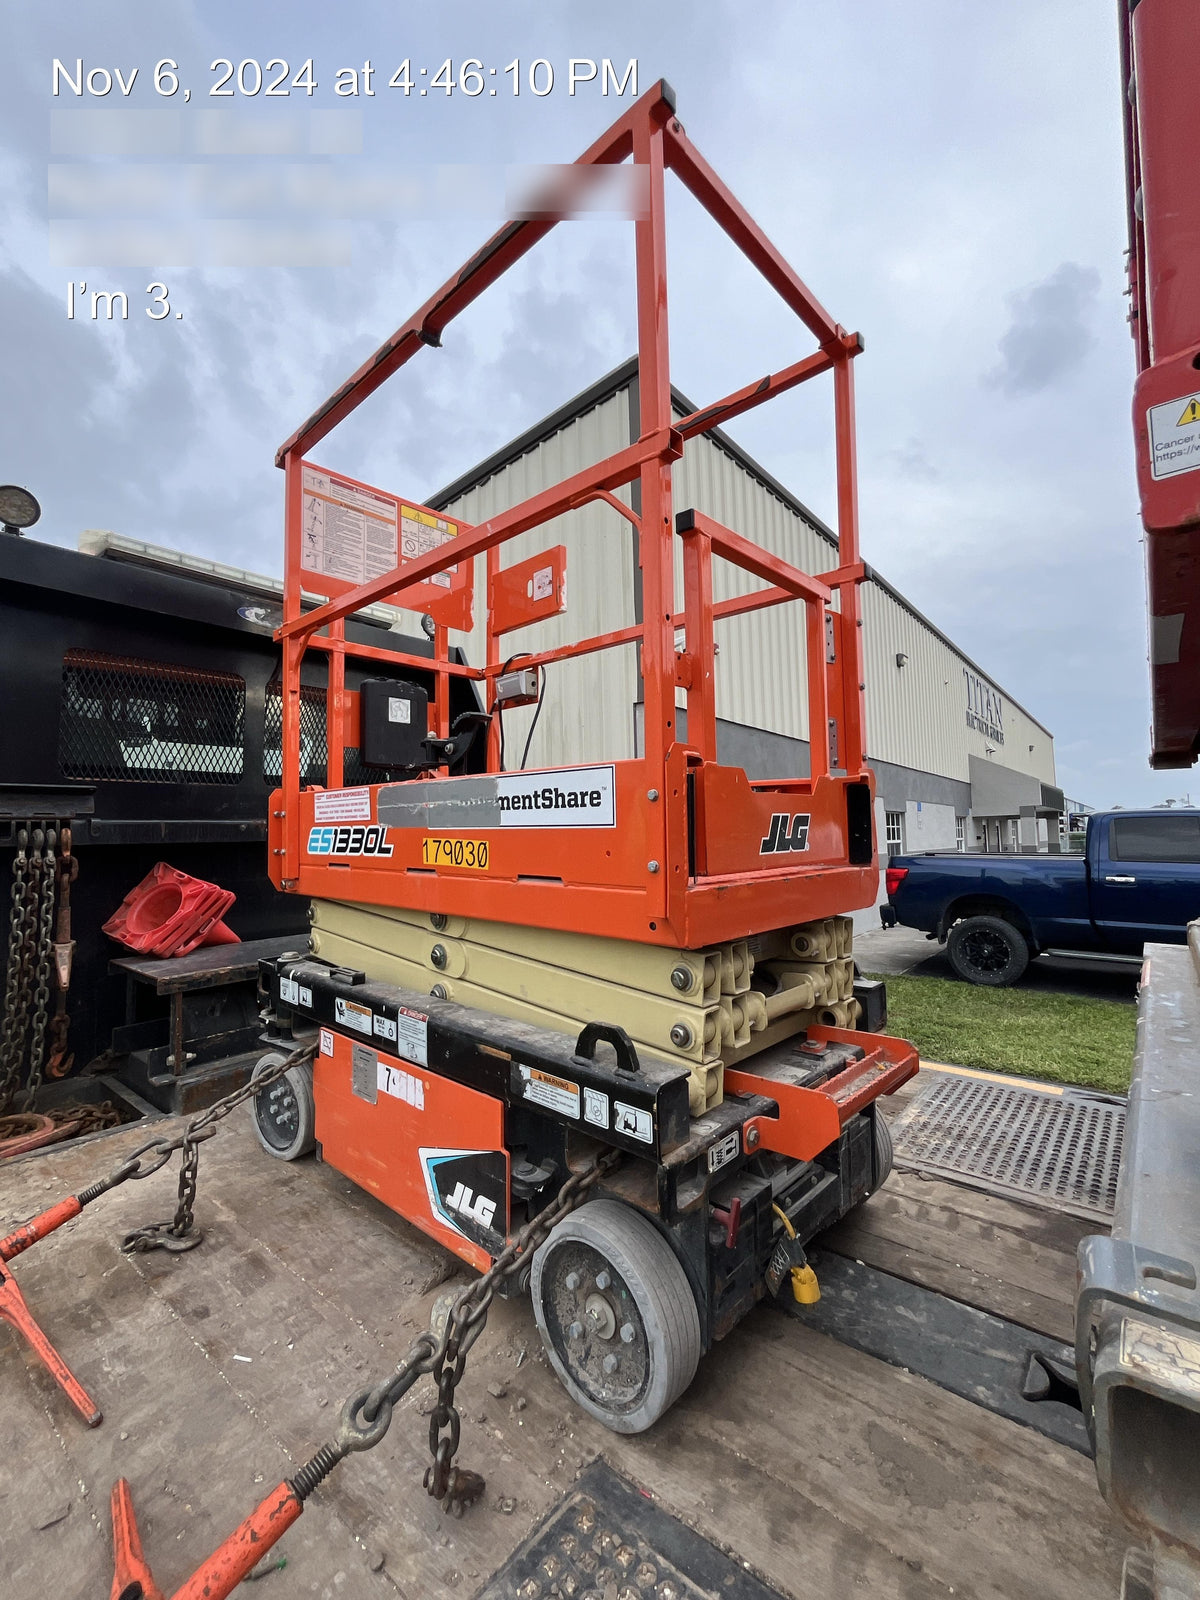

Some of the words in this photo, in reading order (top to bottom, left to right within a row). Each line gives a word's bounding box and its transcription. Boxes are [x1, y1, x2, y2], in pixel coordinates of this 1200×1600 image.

[1155, 435, 1195, 452] Cancer
[963, 668, 1003, 730] TITAN
[308, 827, 393, 857] ES1330L
[759, 813, 812, 856] JLG
[423, 839, 488, 868] 179030
[445, 1181, 497, 1230] JLG
